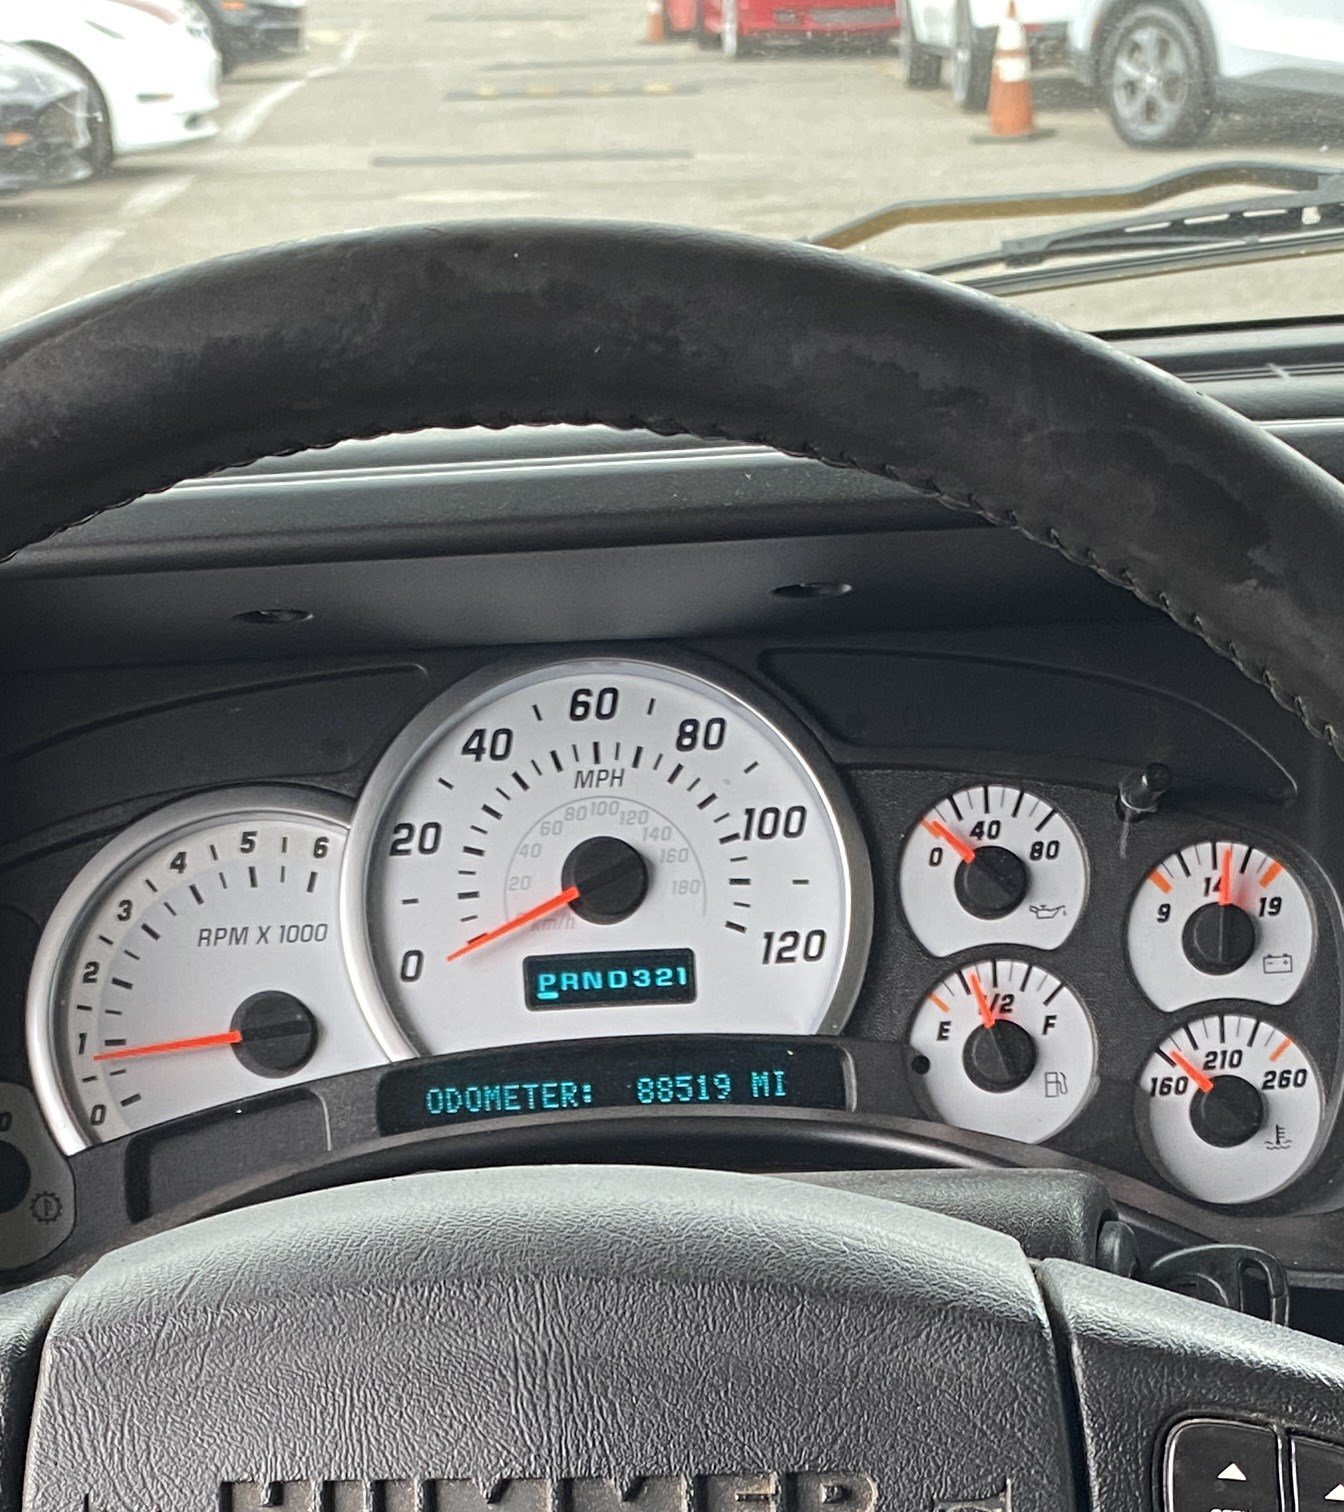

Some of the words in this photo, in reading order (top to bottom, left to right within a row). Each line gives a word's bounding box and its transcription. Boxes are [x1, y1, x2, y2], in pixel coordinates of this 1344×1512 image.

[569, 688, 619, 721] 60
[462, 728, 513, 762] 40
[676, 717, 726, 752] 80
[574, 768, 625, 789] MPH
[590, 800, 620, 816] 100
[743, 805, 807, 842] 100
[970, 820, 1001, 840] 40
[239, 831, 258, 854] 5
[313, 836, 330, 859] 6
[389, 821, 442, 857] 20
[1029, 840, 1060, 861] 80
[169, 851, 188, 874] 4
[928, 847, 943, 867] 0
[117, 899, 133, 922] 3
[1156, 903, 1171, 923] 9
[1259, 897, 1282, 917] 19
[198, 926, 249, 948] RPM
[256, 926, 272, 944] X
[279, 923, 328, 945] 1000
[762, 929, 825, 965] 120
[82, 961, 100, 984] 2
[400, 949, 424, 983] 0
[979, 993, 1015, 1014] /2
[937, 1021, 952, 1041] E
[1042, 1014, 1058, 1036] F
[78, 1032, 88, 1055] 1
[1202, 1050, 1242, 1070] 210
[1150, 1074, 1189, 1096] 160
[1262, 1068, 1308, 1091] 260
[425, 1080, 593, 1115] ODOMETER:
[636, 1073, 731, 1105] 88519
[751, 1070, 786, 1099] MI
[89, 1104, 106, 1126] 0
